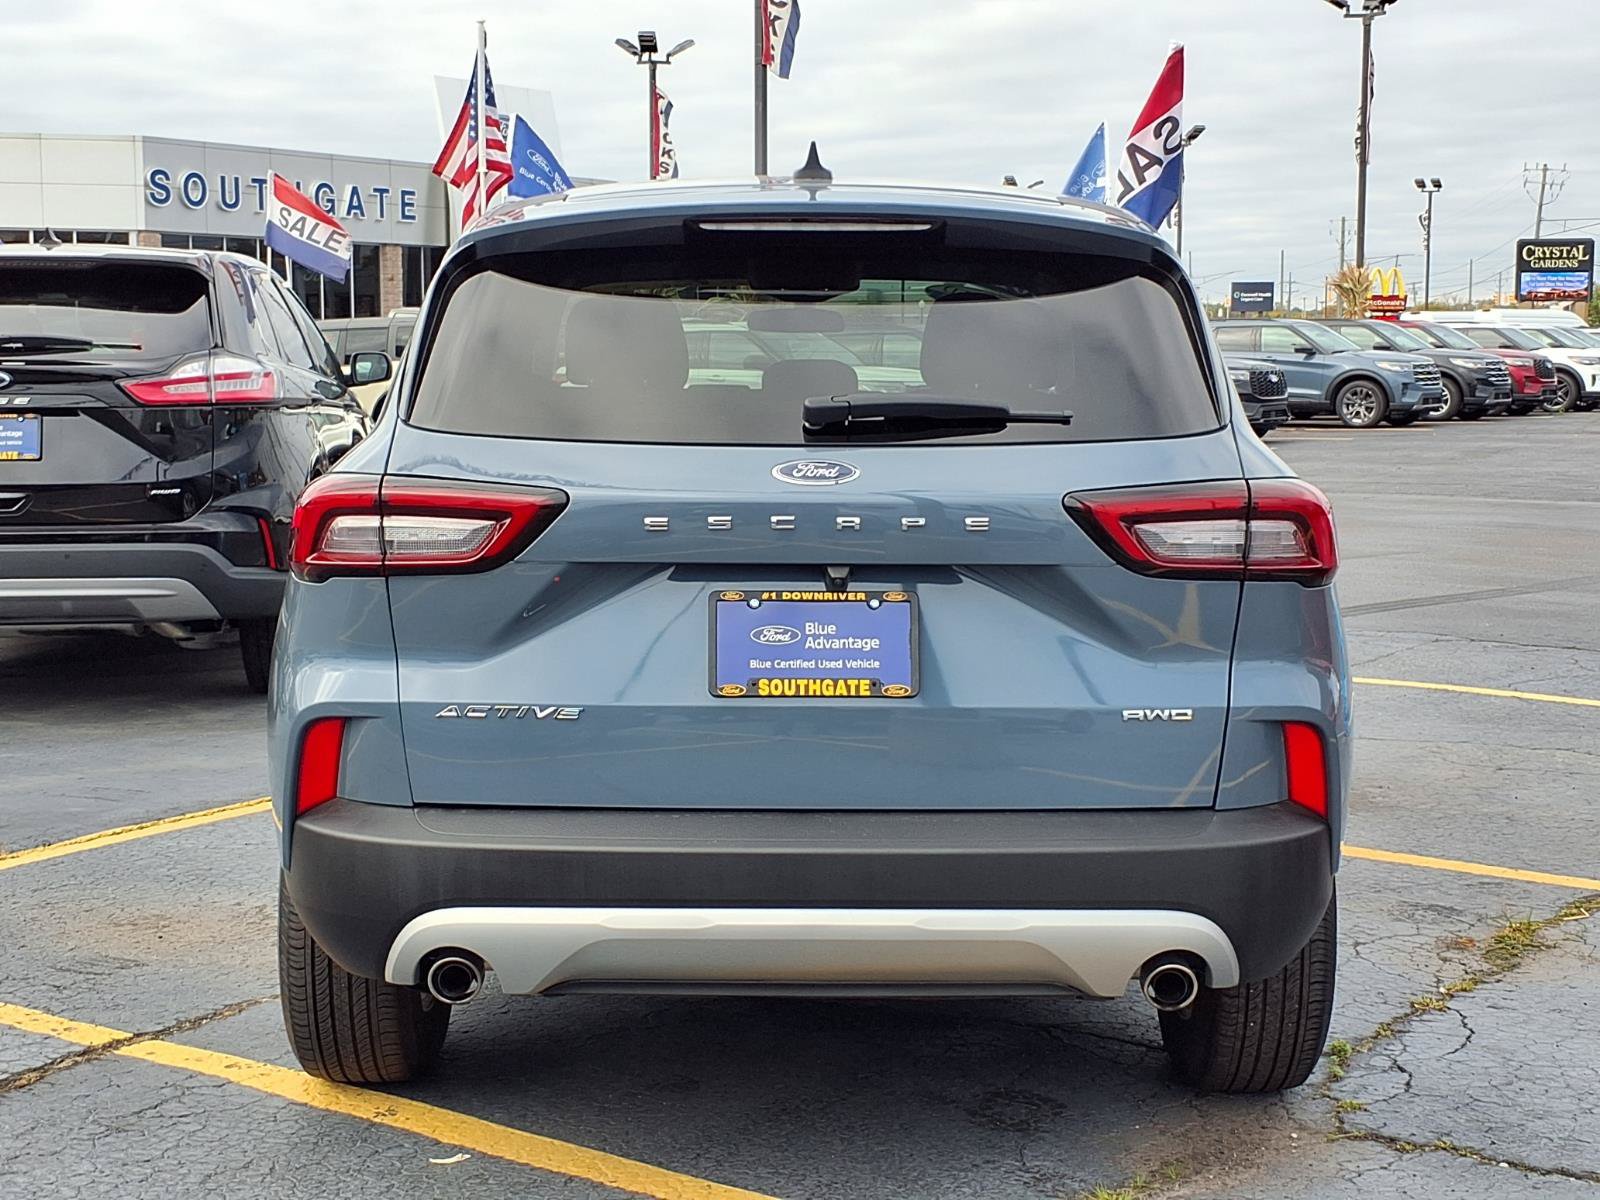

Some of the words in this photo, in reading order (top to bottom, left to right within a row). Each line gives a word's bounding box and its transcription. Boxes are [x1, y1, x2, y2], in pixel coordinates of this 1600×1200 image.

[146, 166, 418, 222] SOUTGATE
[278, 205, 348, 253] SALE
[1522, 245, 1590, 261] CRYSTAL
[1530, 260, 1579, 268] GARDENS
[792, 461, 839, 479] Ford
[643, 515, 990, 532] ESCAPE
[761, 591, 777, 600] #1
[782, 592, 866, 601] DOWNRIVER
[760, 628, 792, 642] Ford
[805, 622, 837, 635] Blue
[805, 636, 880, 651] Advantage
[750, 659, 771, 669] Blue
[774, 659, 814, 669] Certified
[818, 659, 842, 669] Used
[845, 659, 880, 669] Vehicle
[758, 678, 871, 696] SOUTHGATE
[435, 705, 584, 720] ACTIVE
[1122, 708, 1193, 721] AWD
